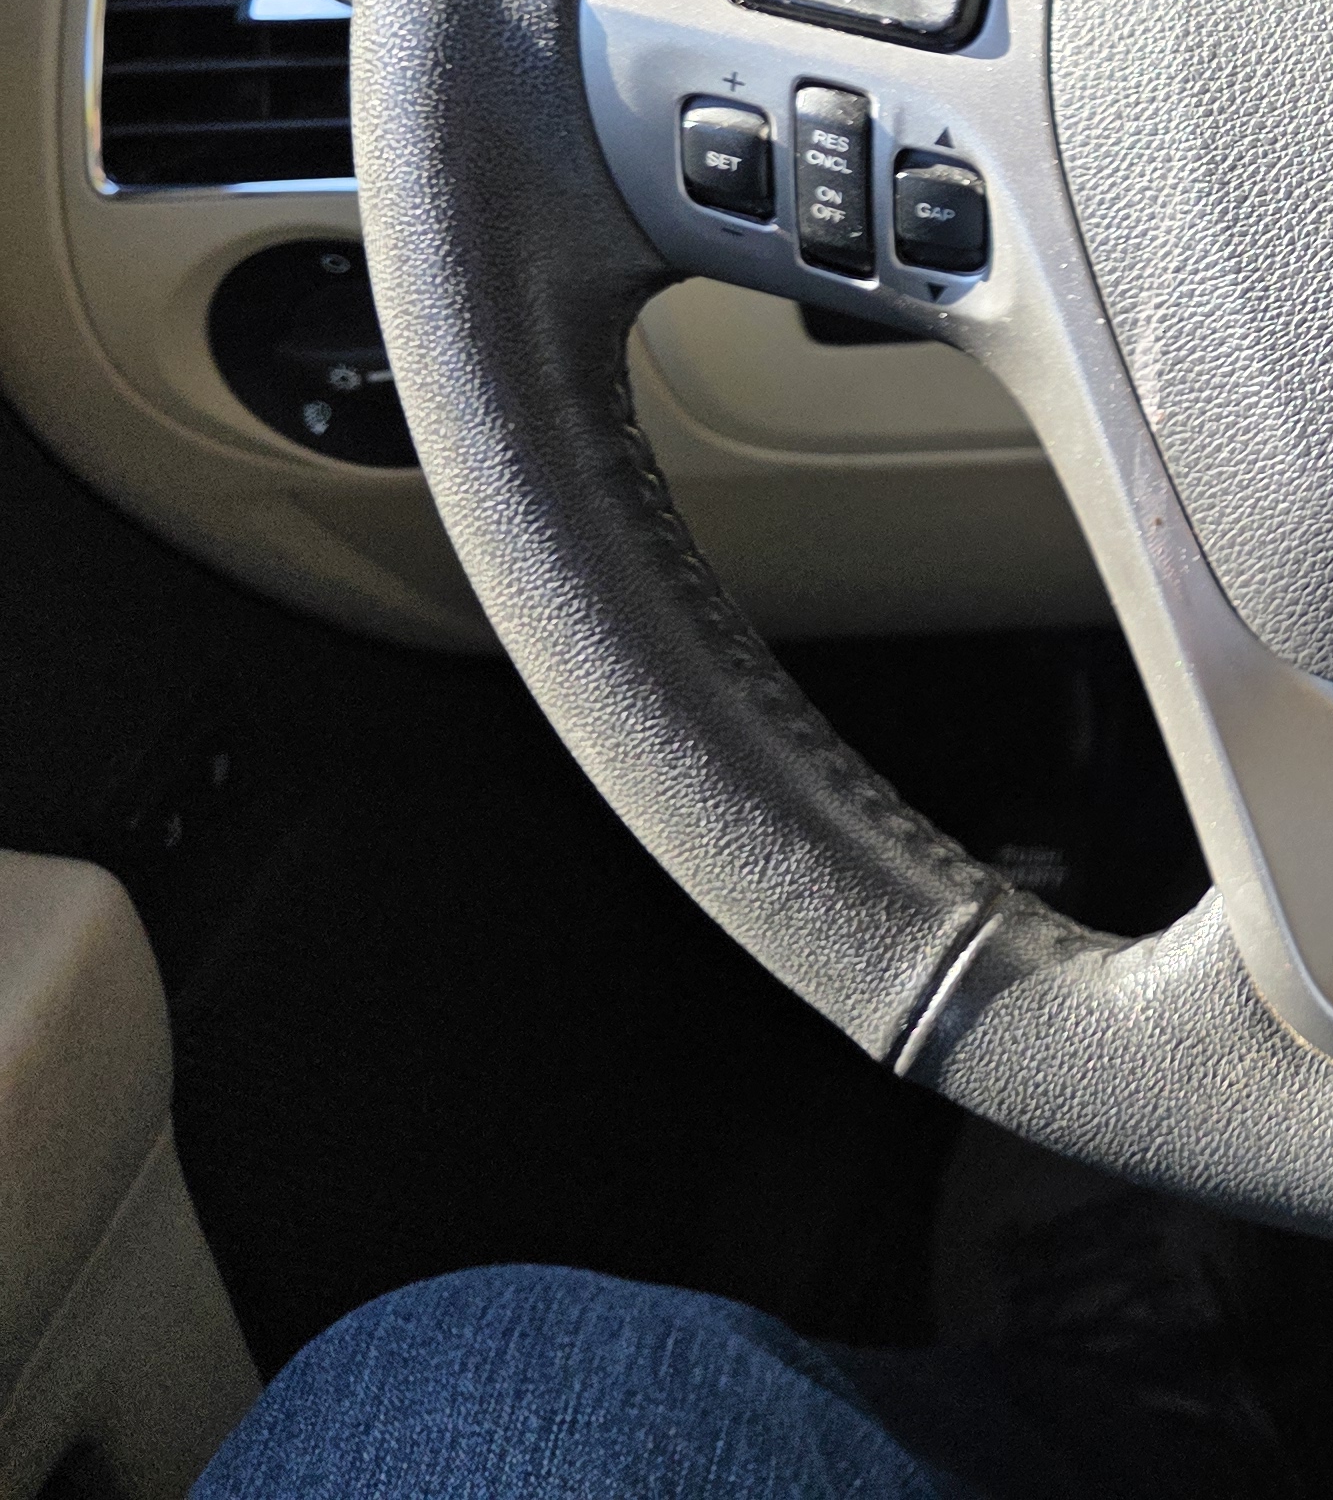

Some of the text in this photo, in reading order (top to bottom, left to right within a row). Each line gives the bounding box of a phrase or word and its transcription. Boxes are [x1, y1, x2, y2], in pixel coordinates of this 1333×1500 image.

[812, 129, 850, 153] RES
[704, 150, 743, 172] SET
[805, 149, 853, 175] CNCL
[815, 185, 843, 205] ON
[810, 202, 846, 223] OFF
[914, 201, 956, 222] GAP
